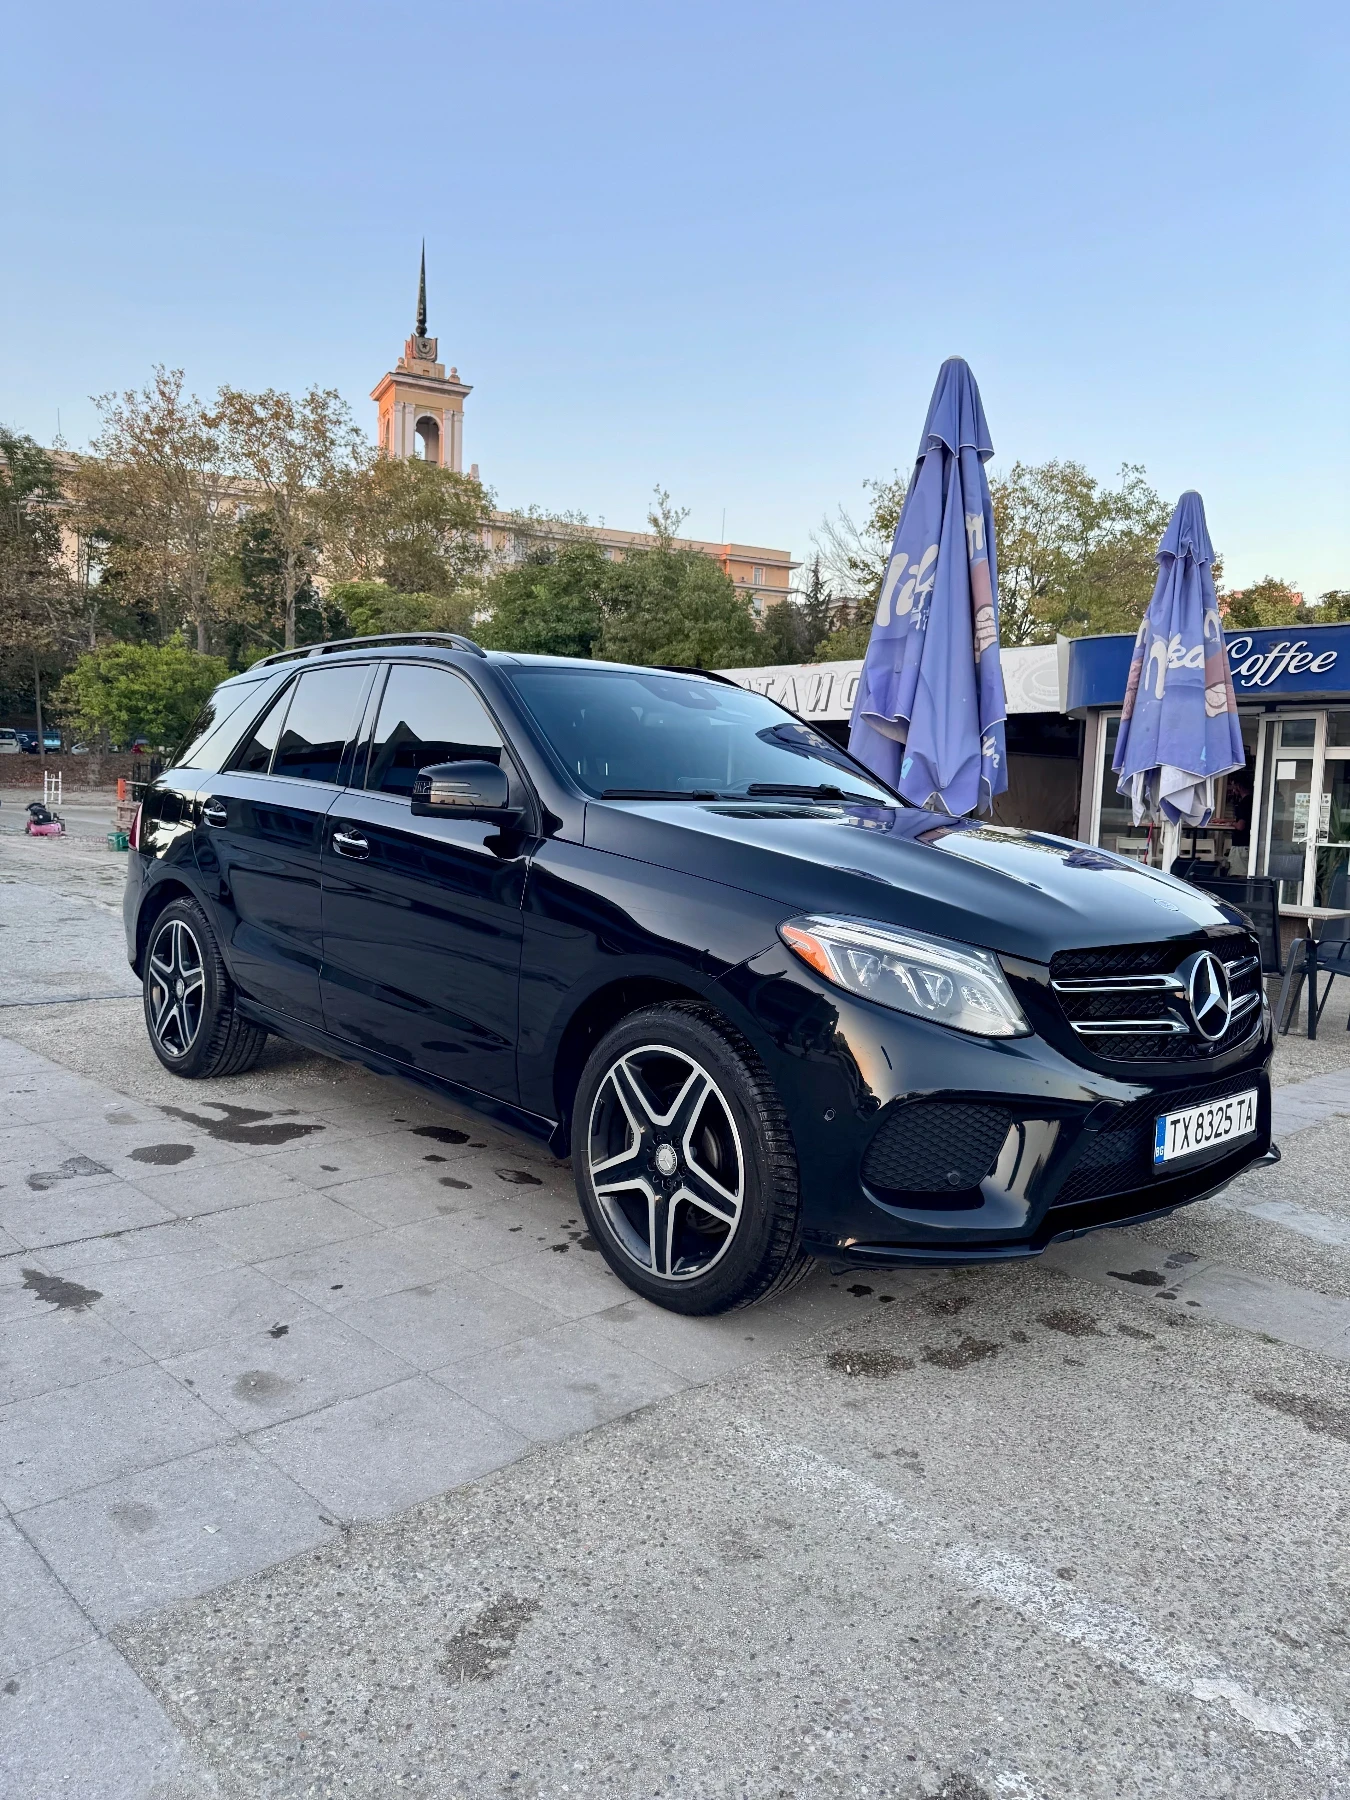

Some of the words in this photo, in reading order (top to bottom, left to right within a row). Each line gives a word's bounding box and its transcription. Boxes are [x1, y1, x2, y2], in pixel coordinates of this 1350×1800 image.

[1226, 636, 1338, 687] Coffee
[1170, 1115, 1193, 1153] TX
[1194, 1102, 1233, 1145] 8325
[1236, 1096, 1253, 1132] TA
[1155, 1145, 1165, 1158] BG
